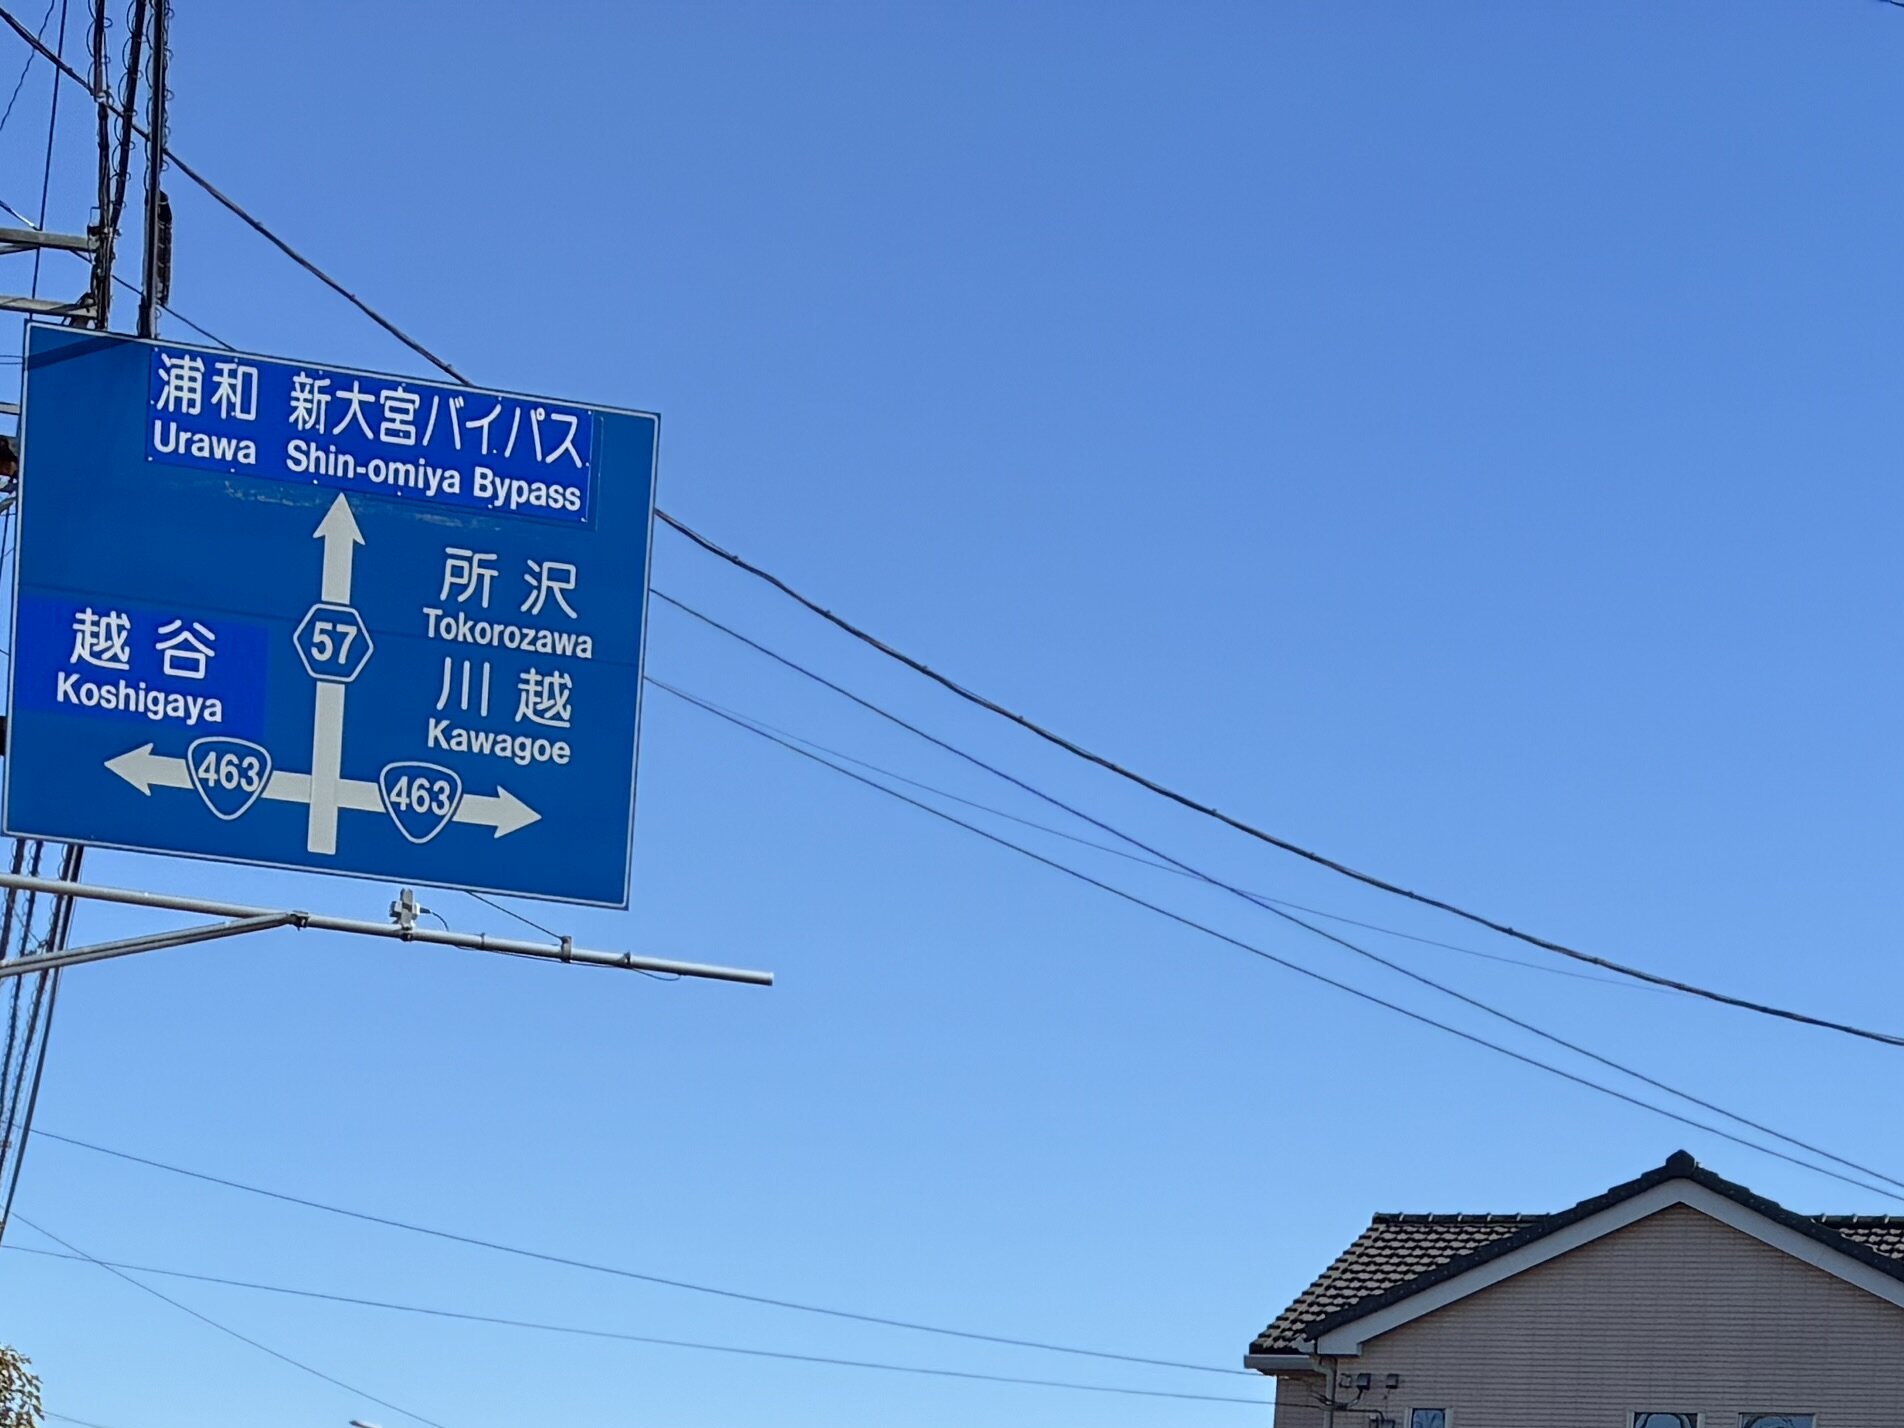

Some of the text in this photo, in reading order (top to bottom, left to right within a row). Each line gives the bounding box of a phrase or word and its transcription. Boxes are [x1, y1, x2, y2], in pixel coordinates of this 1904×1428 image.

[156, 354, 583, 468] 浦和 新大宮バイパス
[153, 419, 582, 511] Urawa Shin-omiya Bypass
[439, 547, 578, 619] 所沢
[70, 608, 216, 679] 越谷
[310, 621, 358, 665] 57
[422, 607, 593, 659] Tokorozawa
[56, 671, 223, 726] Koshigaya
[436, 656, 573, 728] 川越
[427, 718, 572, 766] Kawagoe
[198, 751, 261, 792] 463
[389, 775, 451, 816] 463
